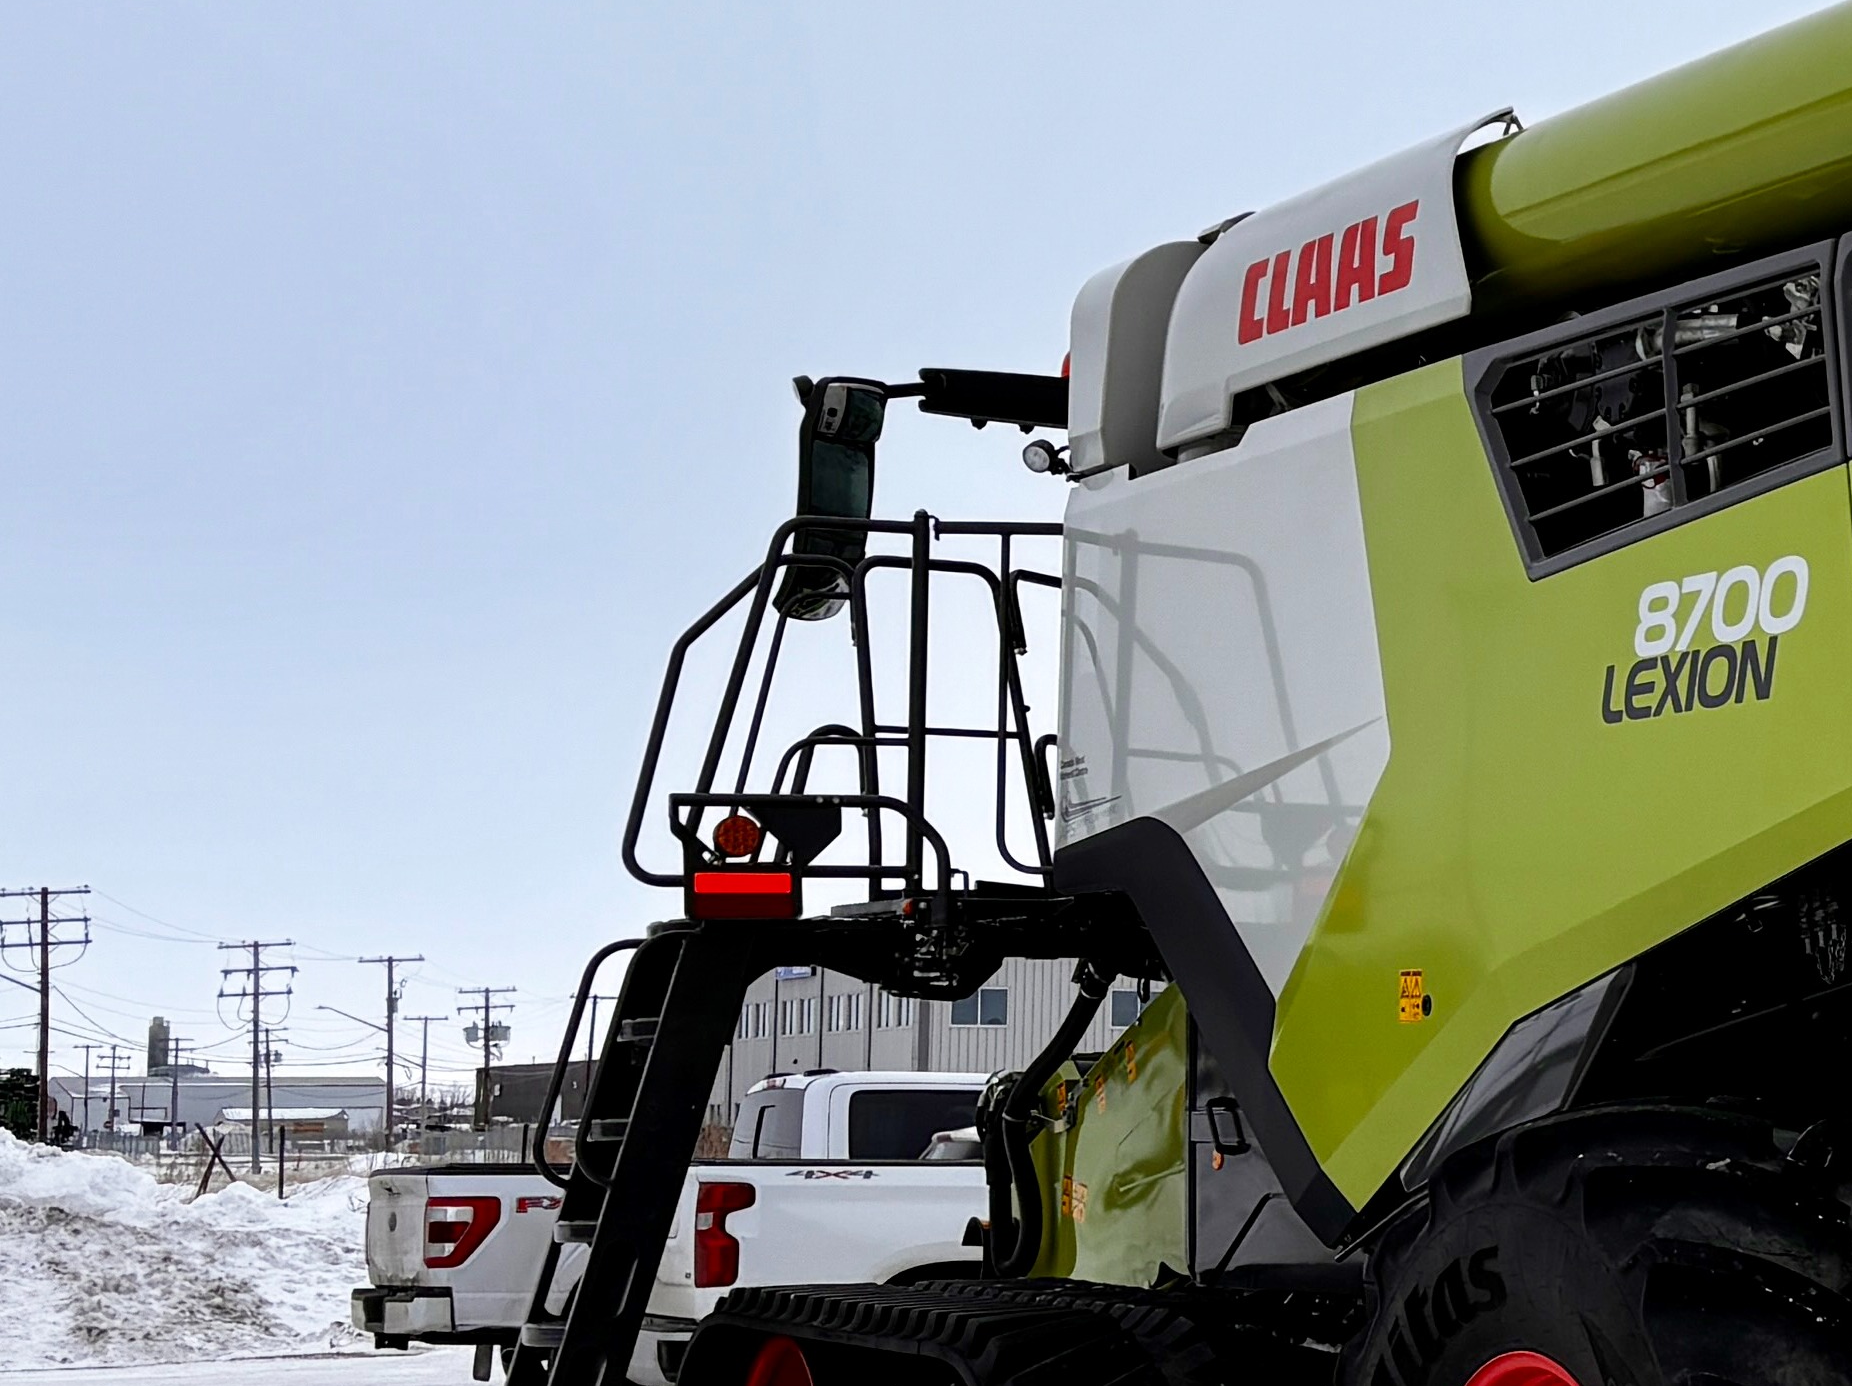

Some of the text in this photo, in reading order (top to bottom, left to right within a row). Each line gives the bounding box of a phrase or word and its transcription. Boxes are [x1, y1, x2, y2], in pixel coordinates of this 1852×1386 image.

[1237, 198, 1420, 346] CLAAS
[1634, 554, 1810, 658] 8700
[1601, 635, 1778, 725] LEXION
